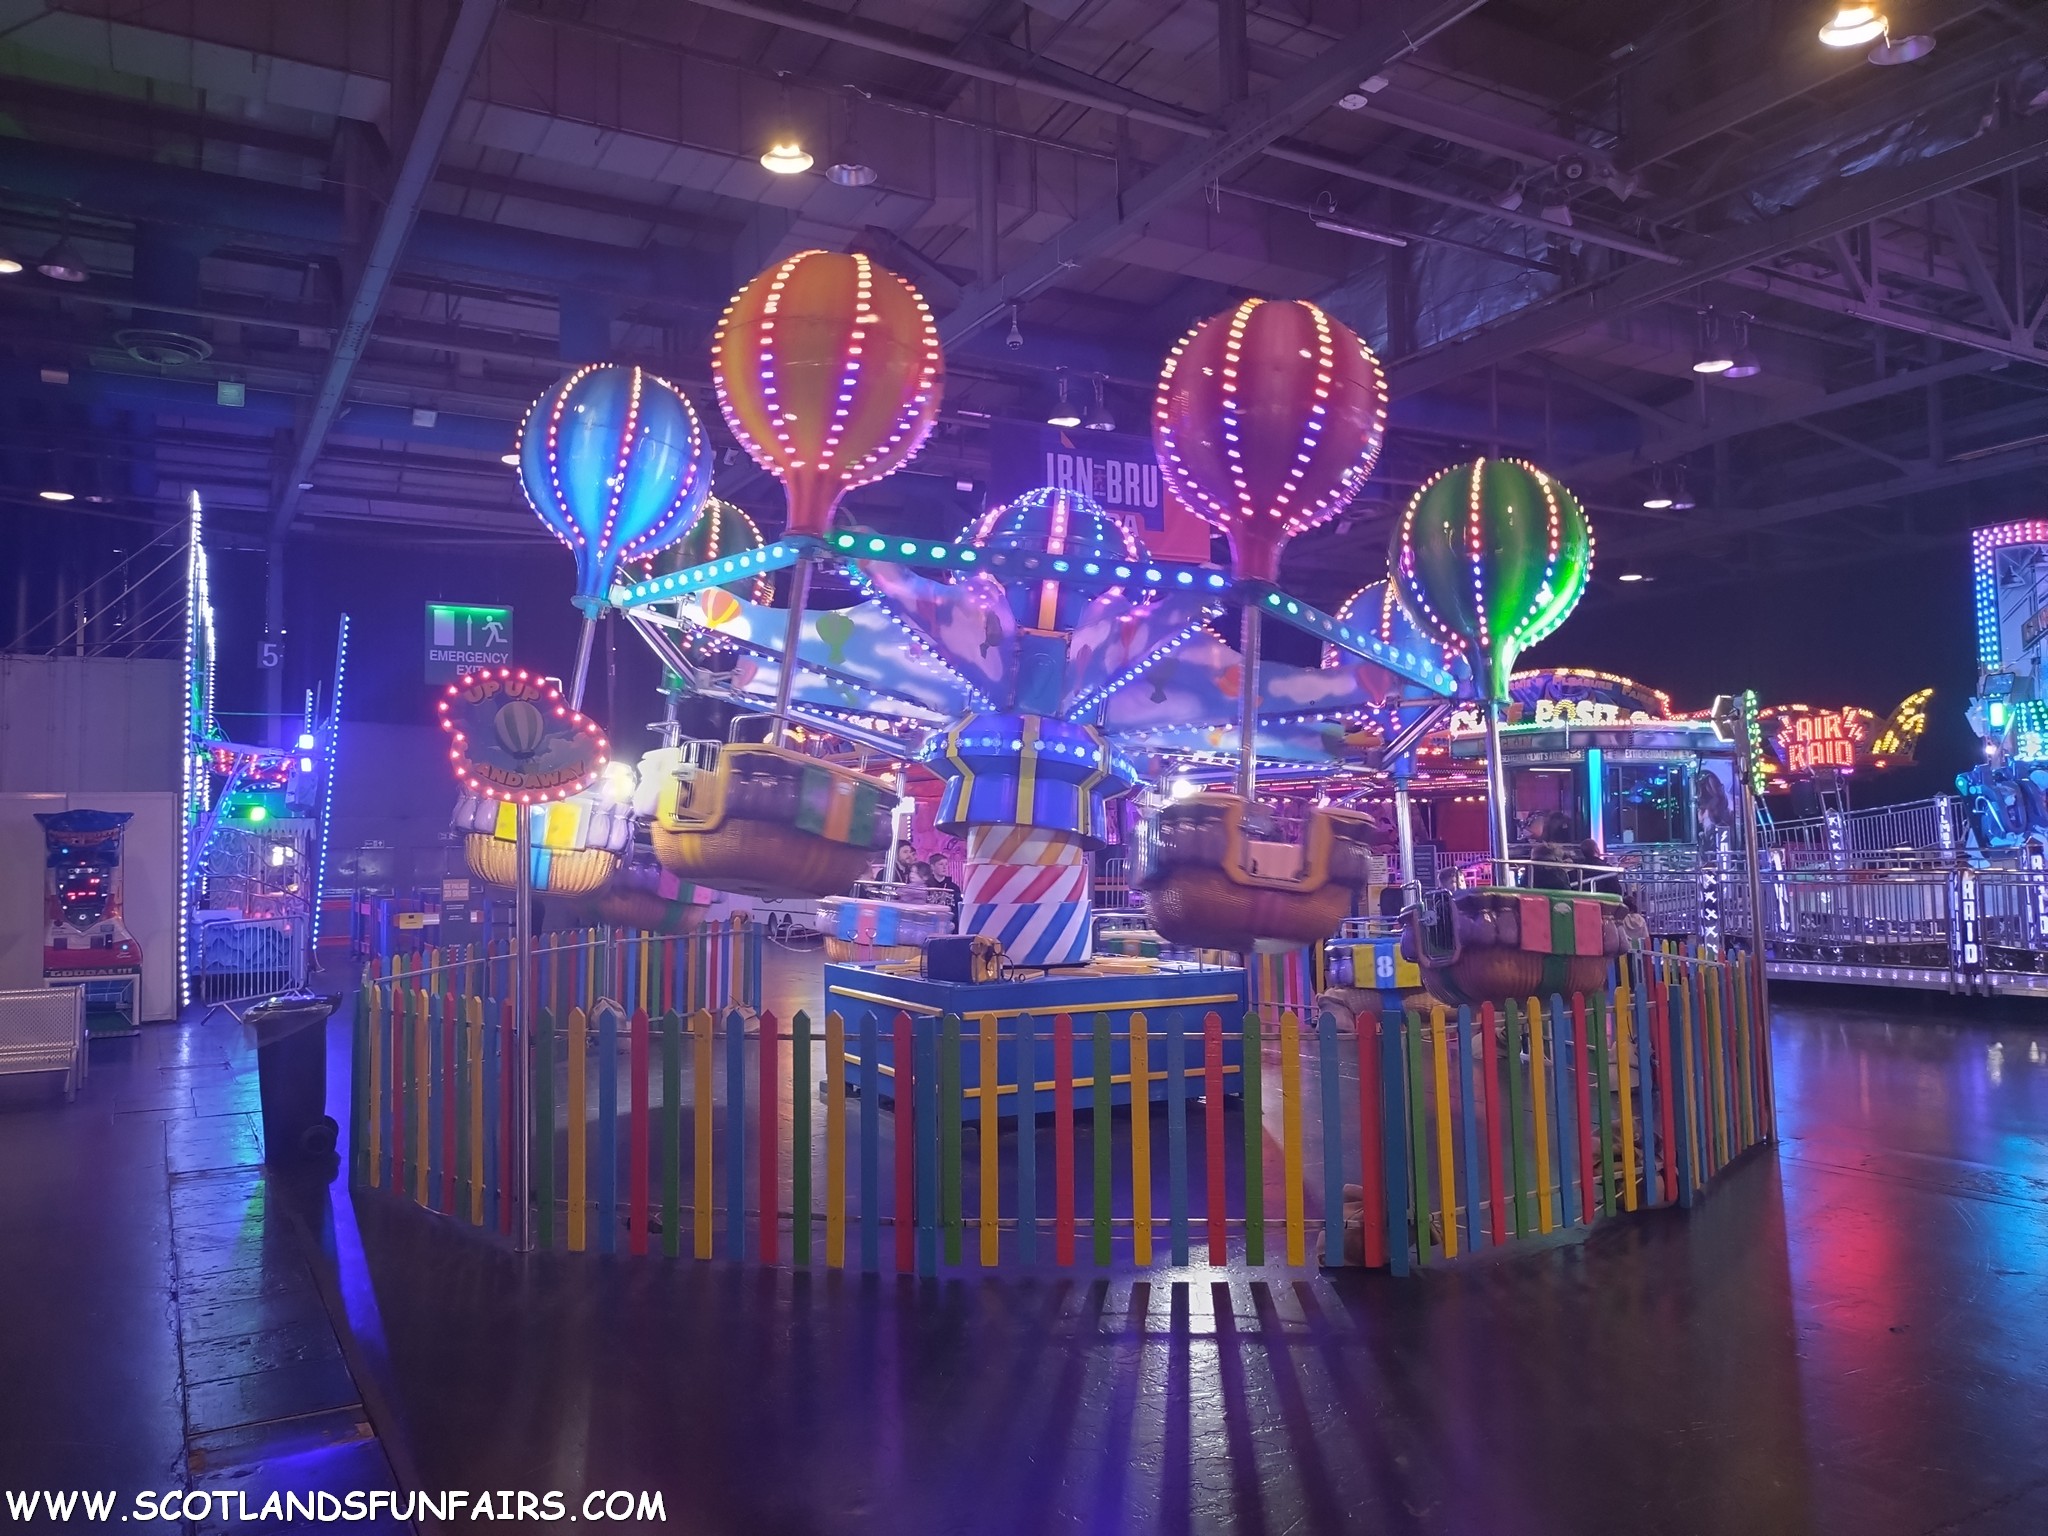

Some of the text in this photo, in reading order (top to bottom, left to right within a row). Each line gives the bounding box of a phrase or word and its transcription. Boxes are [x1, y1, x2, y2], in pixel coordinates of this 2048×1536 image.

[262, 643, 278, 667] 5
[429, 649, 509, 664] EMERGENCY
[456, 664, 484, 676] EXIT
[463, 680, 540, 704] UP UP
[1796, 714, 1842, 741] AIR
[1789, 740, 1855, 771] RAID
[474, 760, 586, 790] AND AWAY
[1962, 879, 1979, 964] RAID
[1377, 955, 1394, 978] 8
